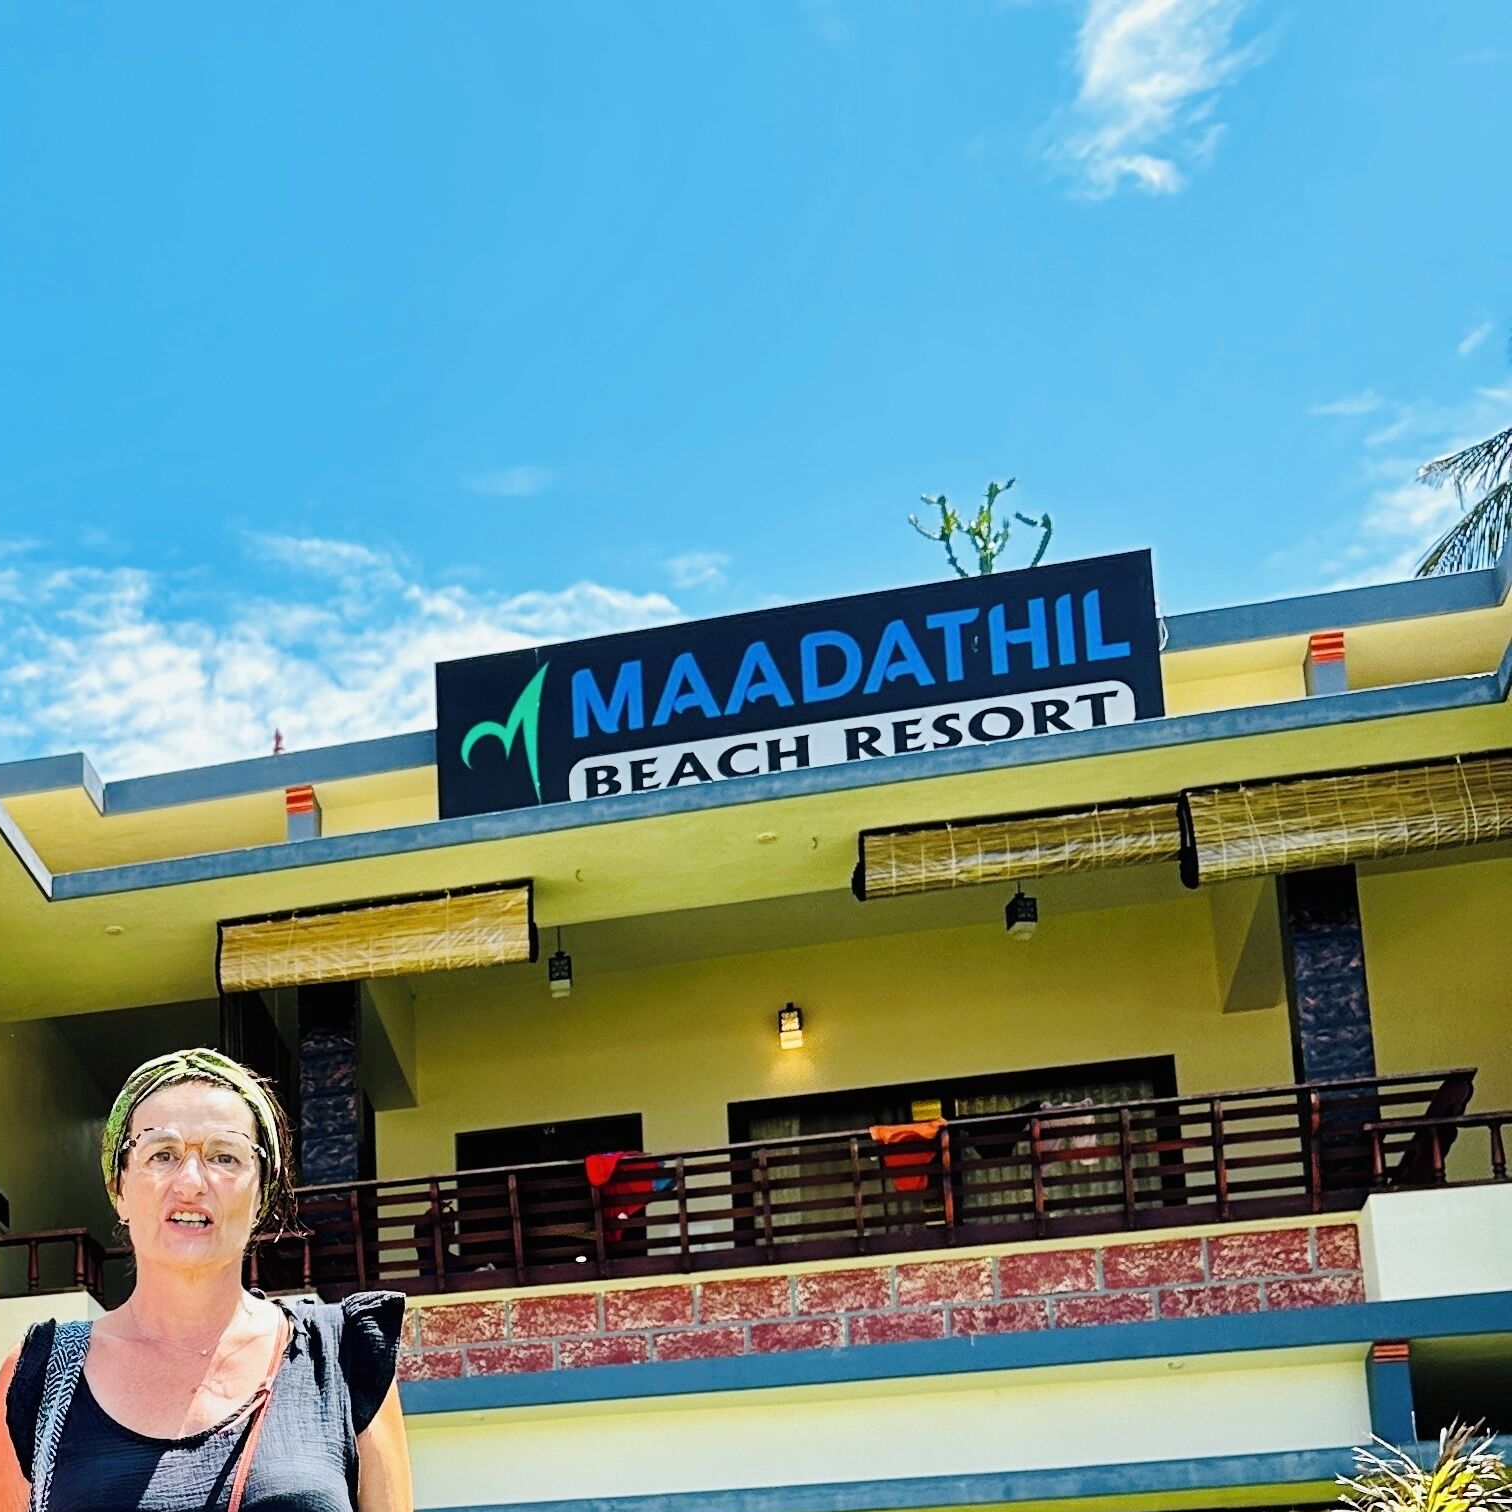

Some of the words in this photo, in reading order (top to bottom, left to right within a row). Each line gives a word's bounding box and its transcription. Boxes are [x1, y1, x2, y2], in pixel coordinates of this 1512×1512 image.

[572, 589, 1131, 739] MAADATHIL
[585, 736, 810, 799] BEACH
[846, 690, 1119, 763] RESORT
